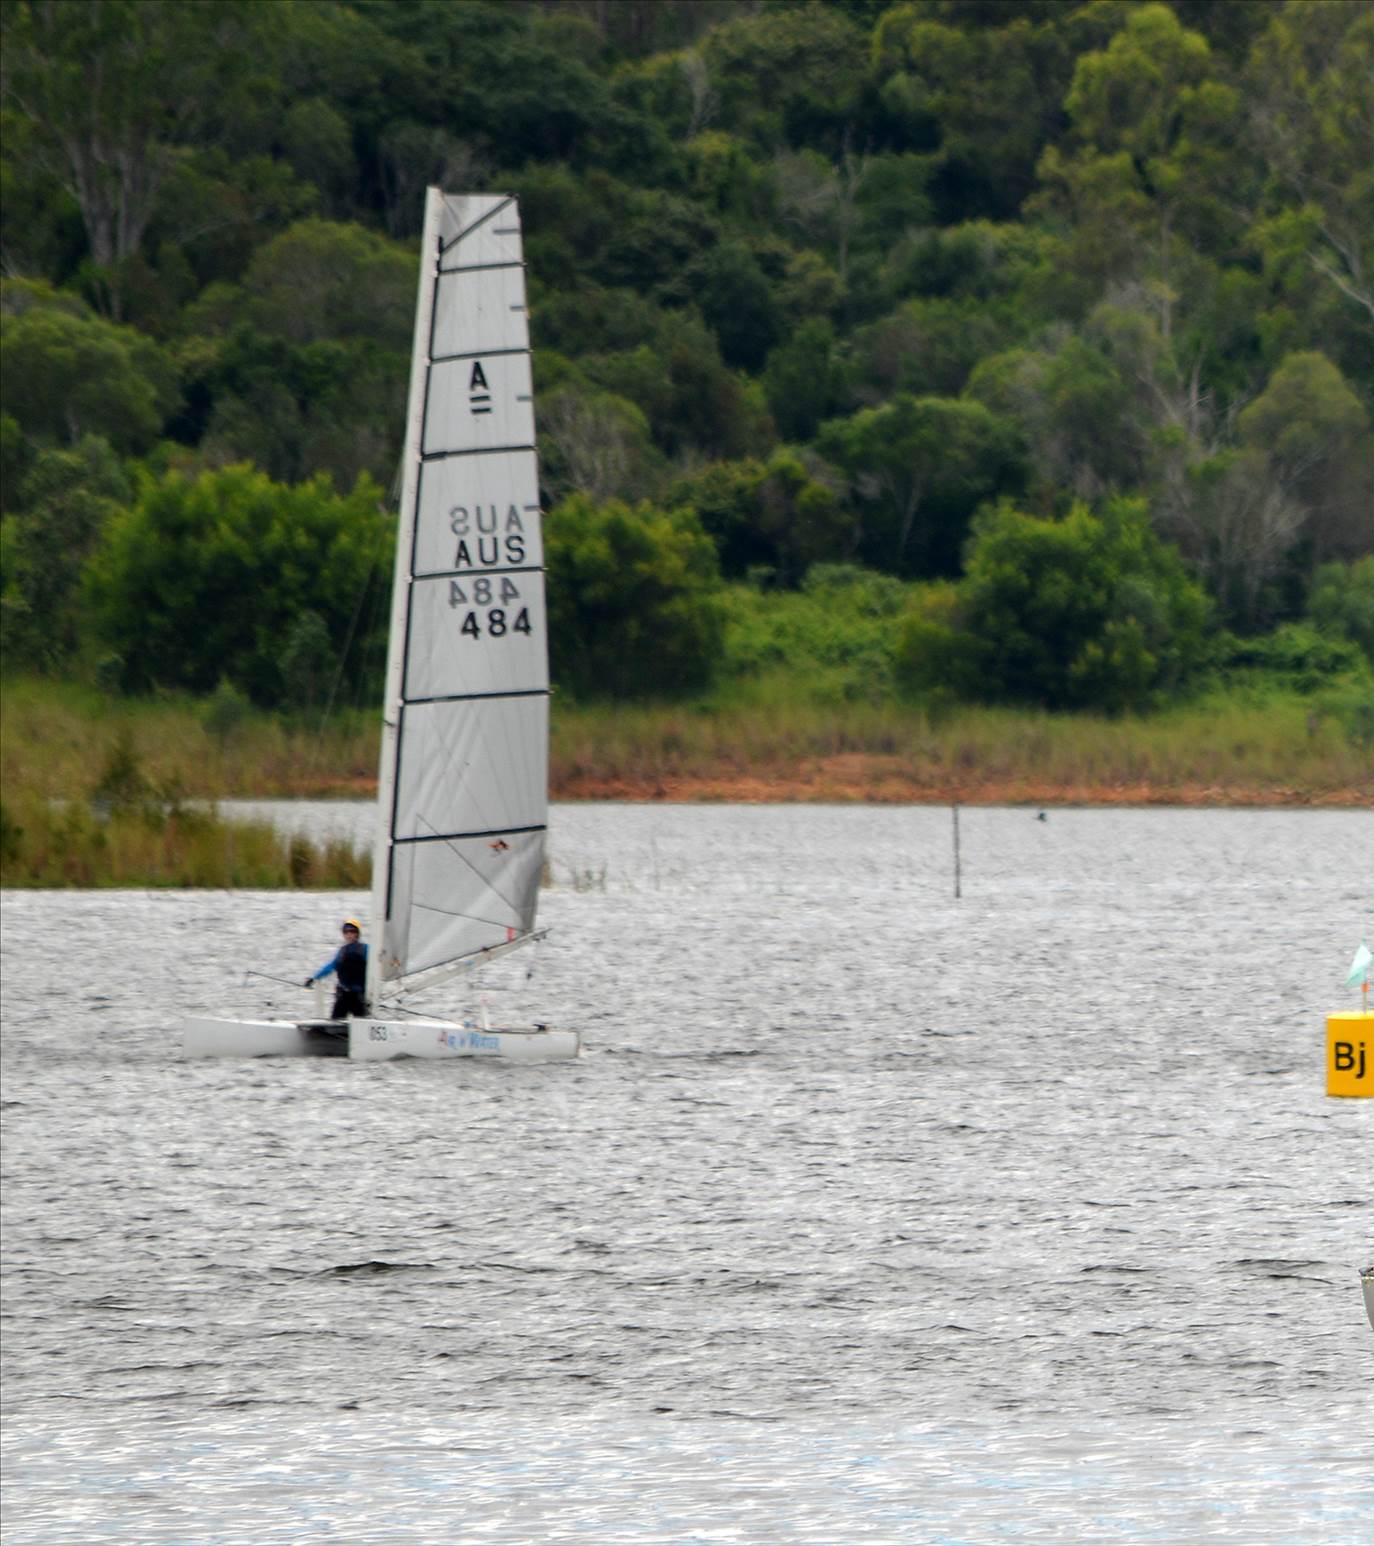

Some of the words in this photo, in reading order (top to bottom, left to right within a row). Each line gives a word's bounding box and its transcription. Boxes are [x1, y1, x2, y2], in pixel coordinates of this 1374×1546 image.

[455, 535, 525, 568] AUS
[461, 607, 532, 639] 484
[1334, 1042, 1366, 1079] Bj
